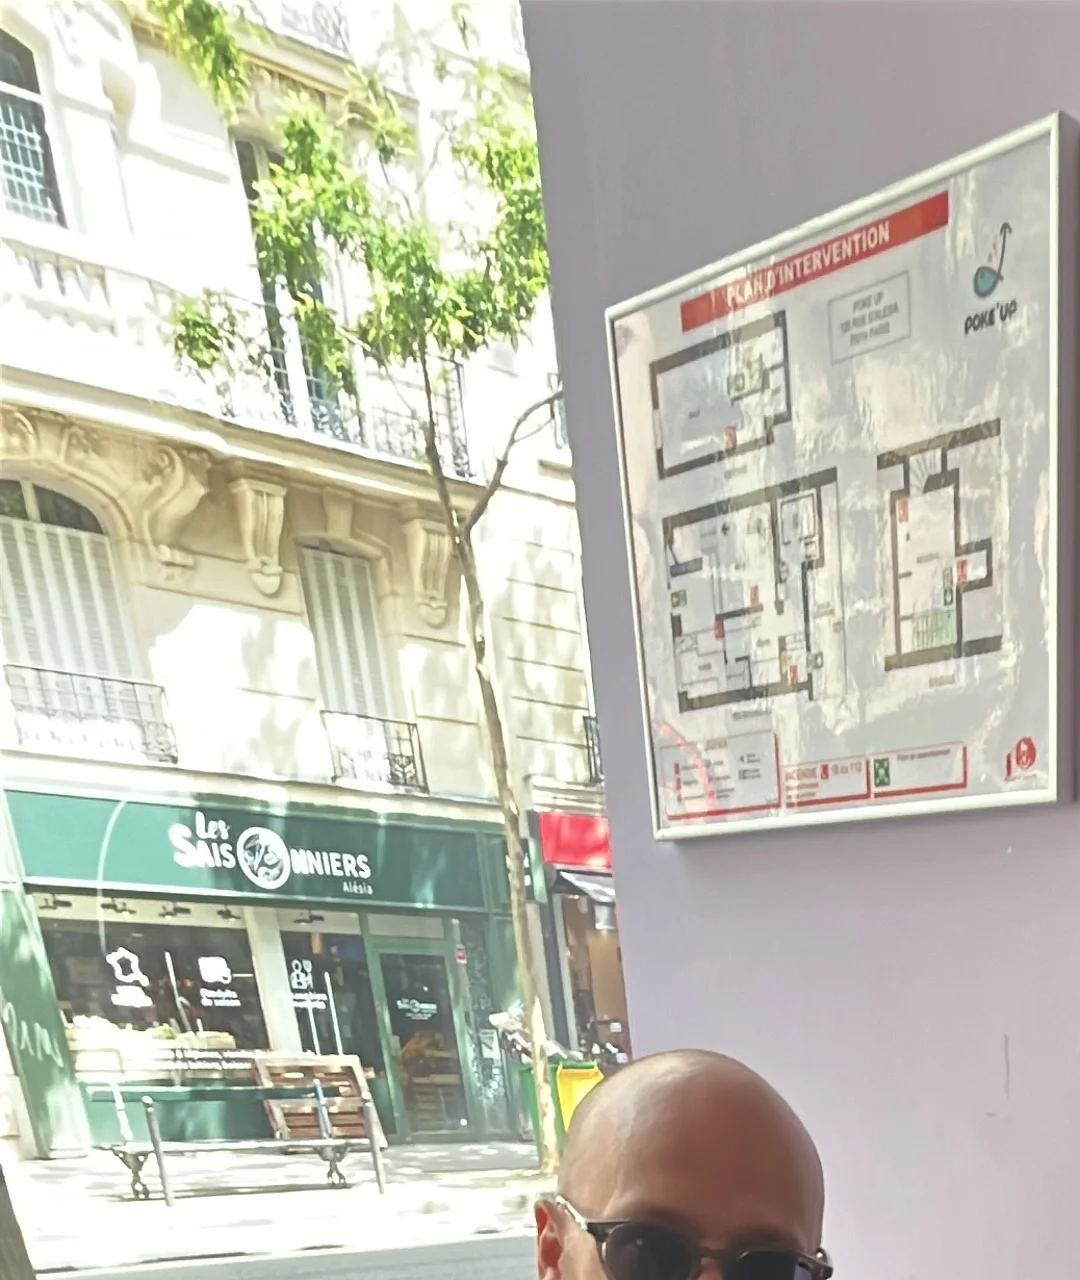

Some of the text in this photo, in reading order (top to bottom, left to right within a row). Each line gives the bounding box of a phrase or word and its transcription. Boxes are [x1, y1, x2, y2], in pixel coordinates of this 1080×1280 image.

[727, 221, 890, 307] PLAN D'INTERVENTION
[195, 811, 230, 840] Les
